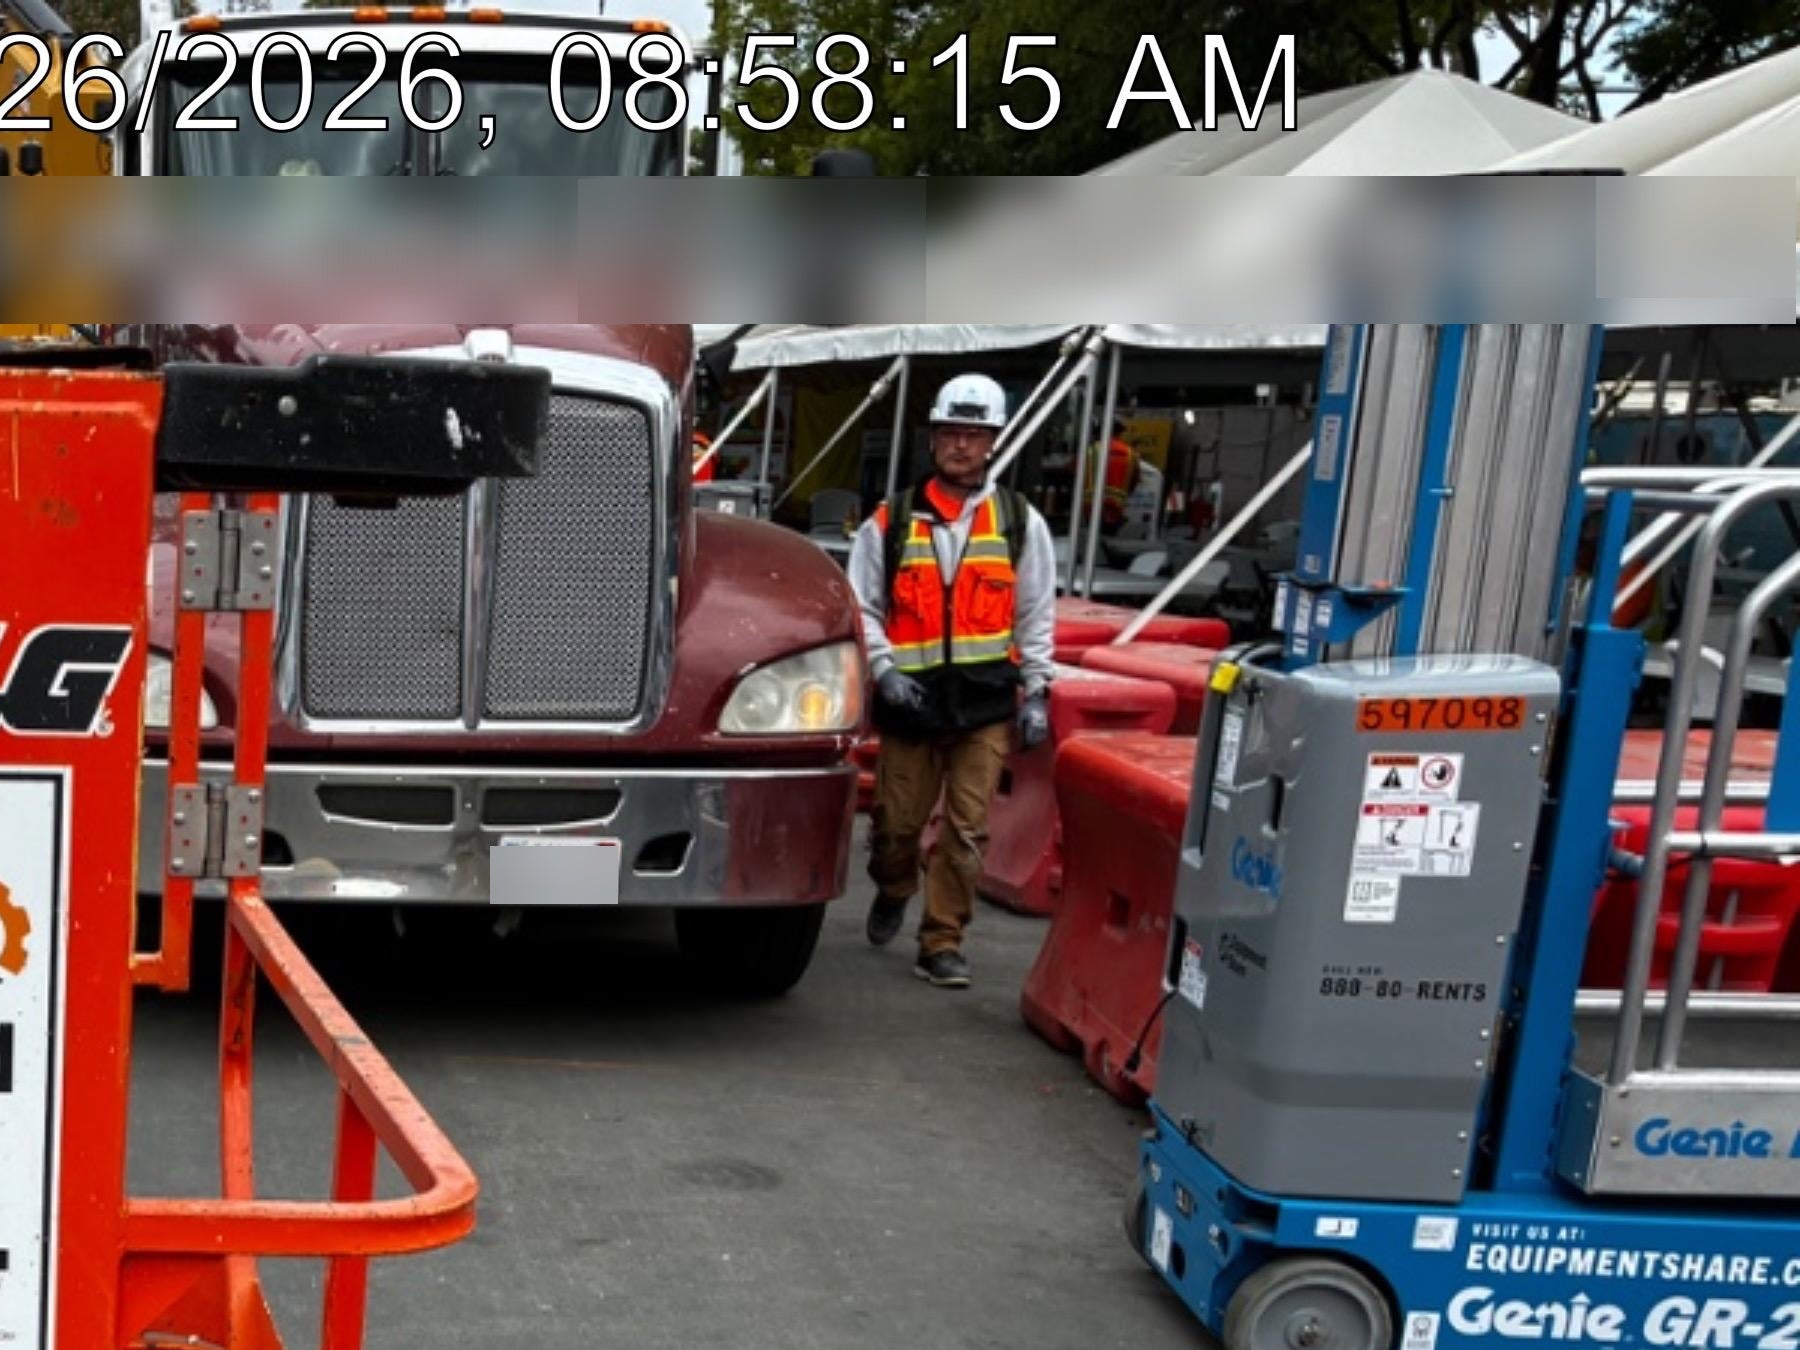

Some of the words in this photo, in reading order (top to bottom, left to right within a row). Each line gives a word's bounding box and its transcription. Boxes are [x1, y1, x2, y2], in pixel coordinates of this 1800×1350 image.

[1361, 697, 1520, 730] 597098
[1634, 1117, 1773, 1158] Genie
[1472, 1223, 1520, 1240] VISIT
[1527, 1225, 1549, 1241] US
[1447, 1286, 1626, 1342] Genie
